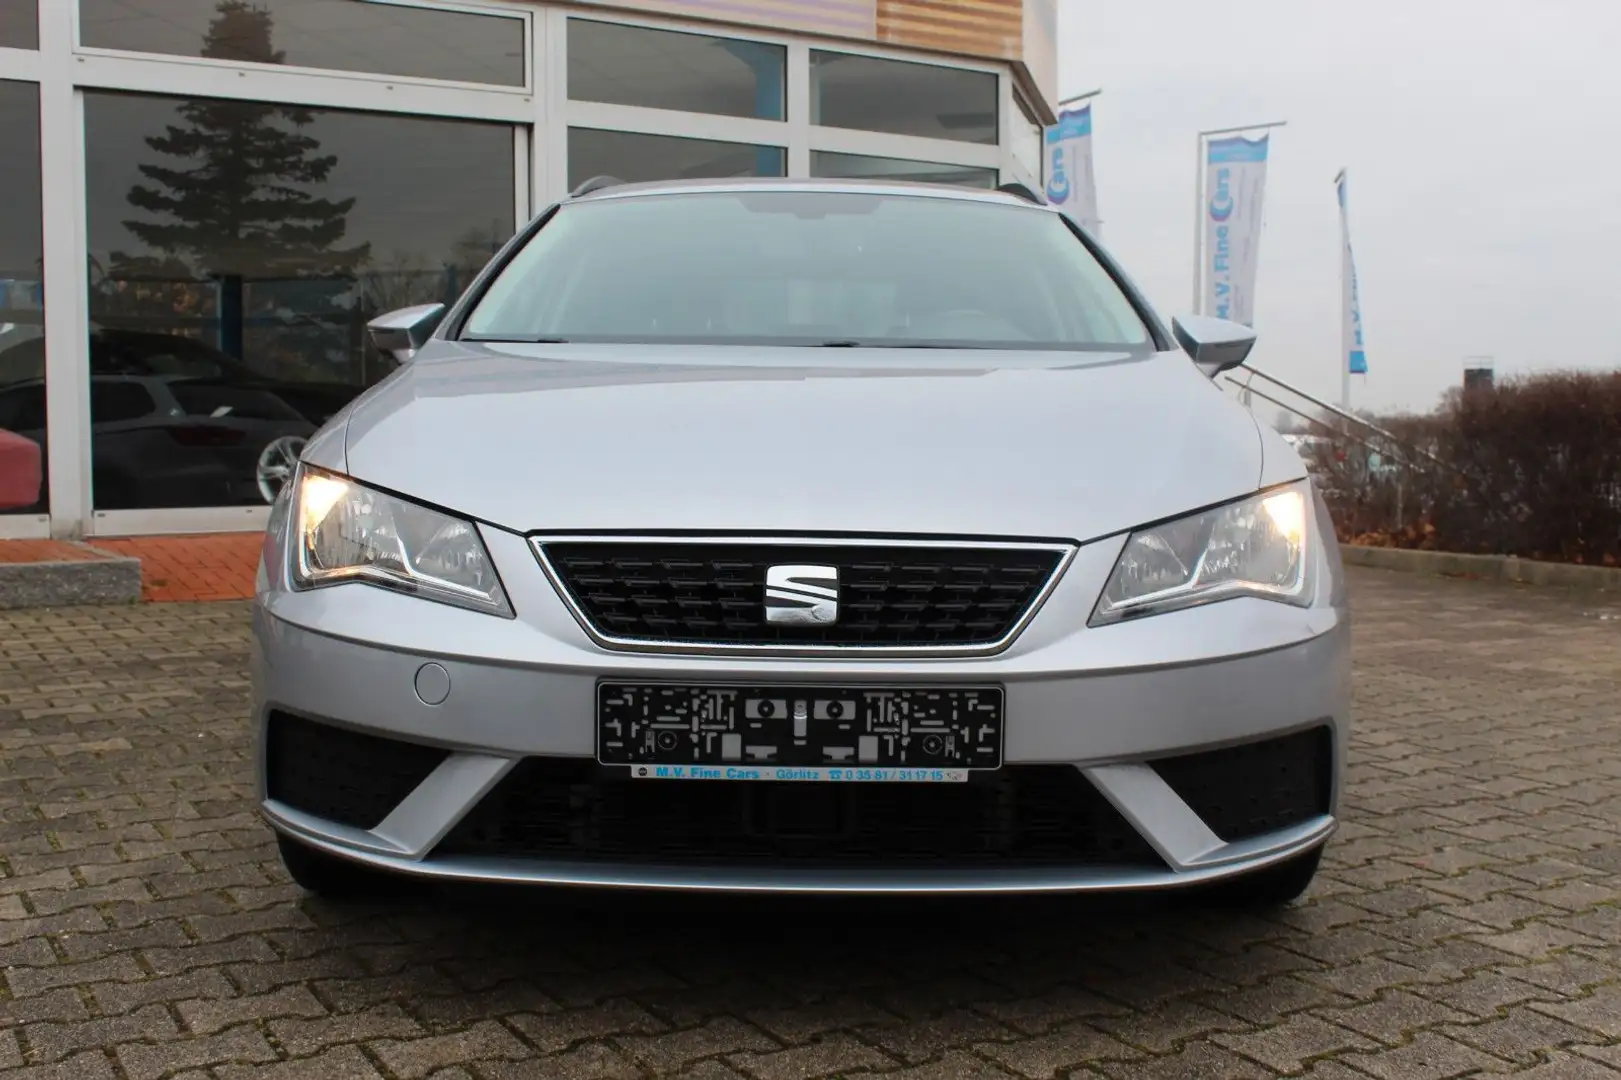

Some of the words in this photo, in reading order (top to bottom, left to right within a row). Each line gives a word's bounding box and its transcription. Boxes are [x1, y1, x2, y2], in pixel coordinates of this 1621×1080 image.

[1047, 147, 1069, 205] Cars
[1209, 167, 1233, 222] Cars
[1213, 225, 1229, 272] Fine
[655, 767, 685, 778] M.V.
[690, 767, 721, 779] Fine
[726, 768, 760, 779] Cars
[775, 768, 819, 780] Görlitz
